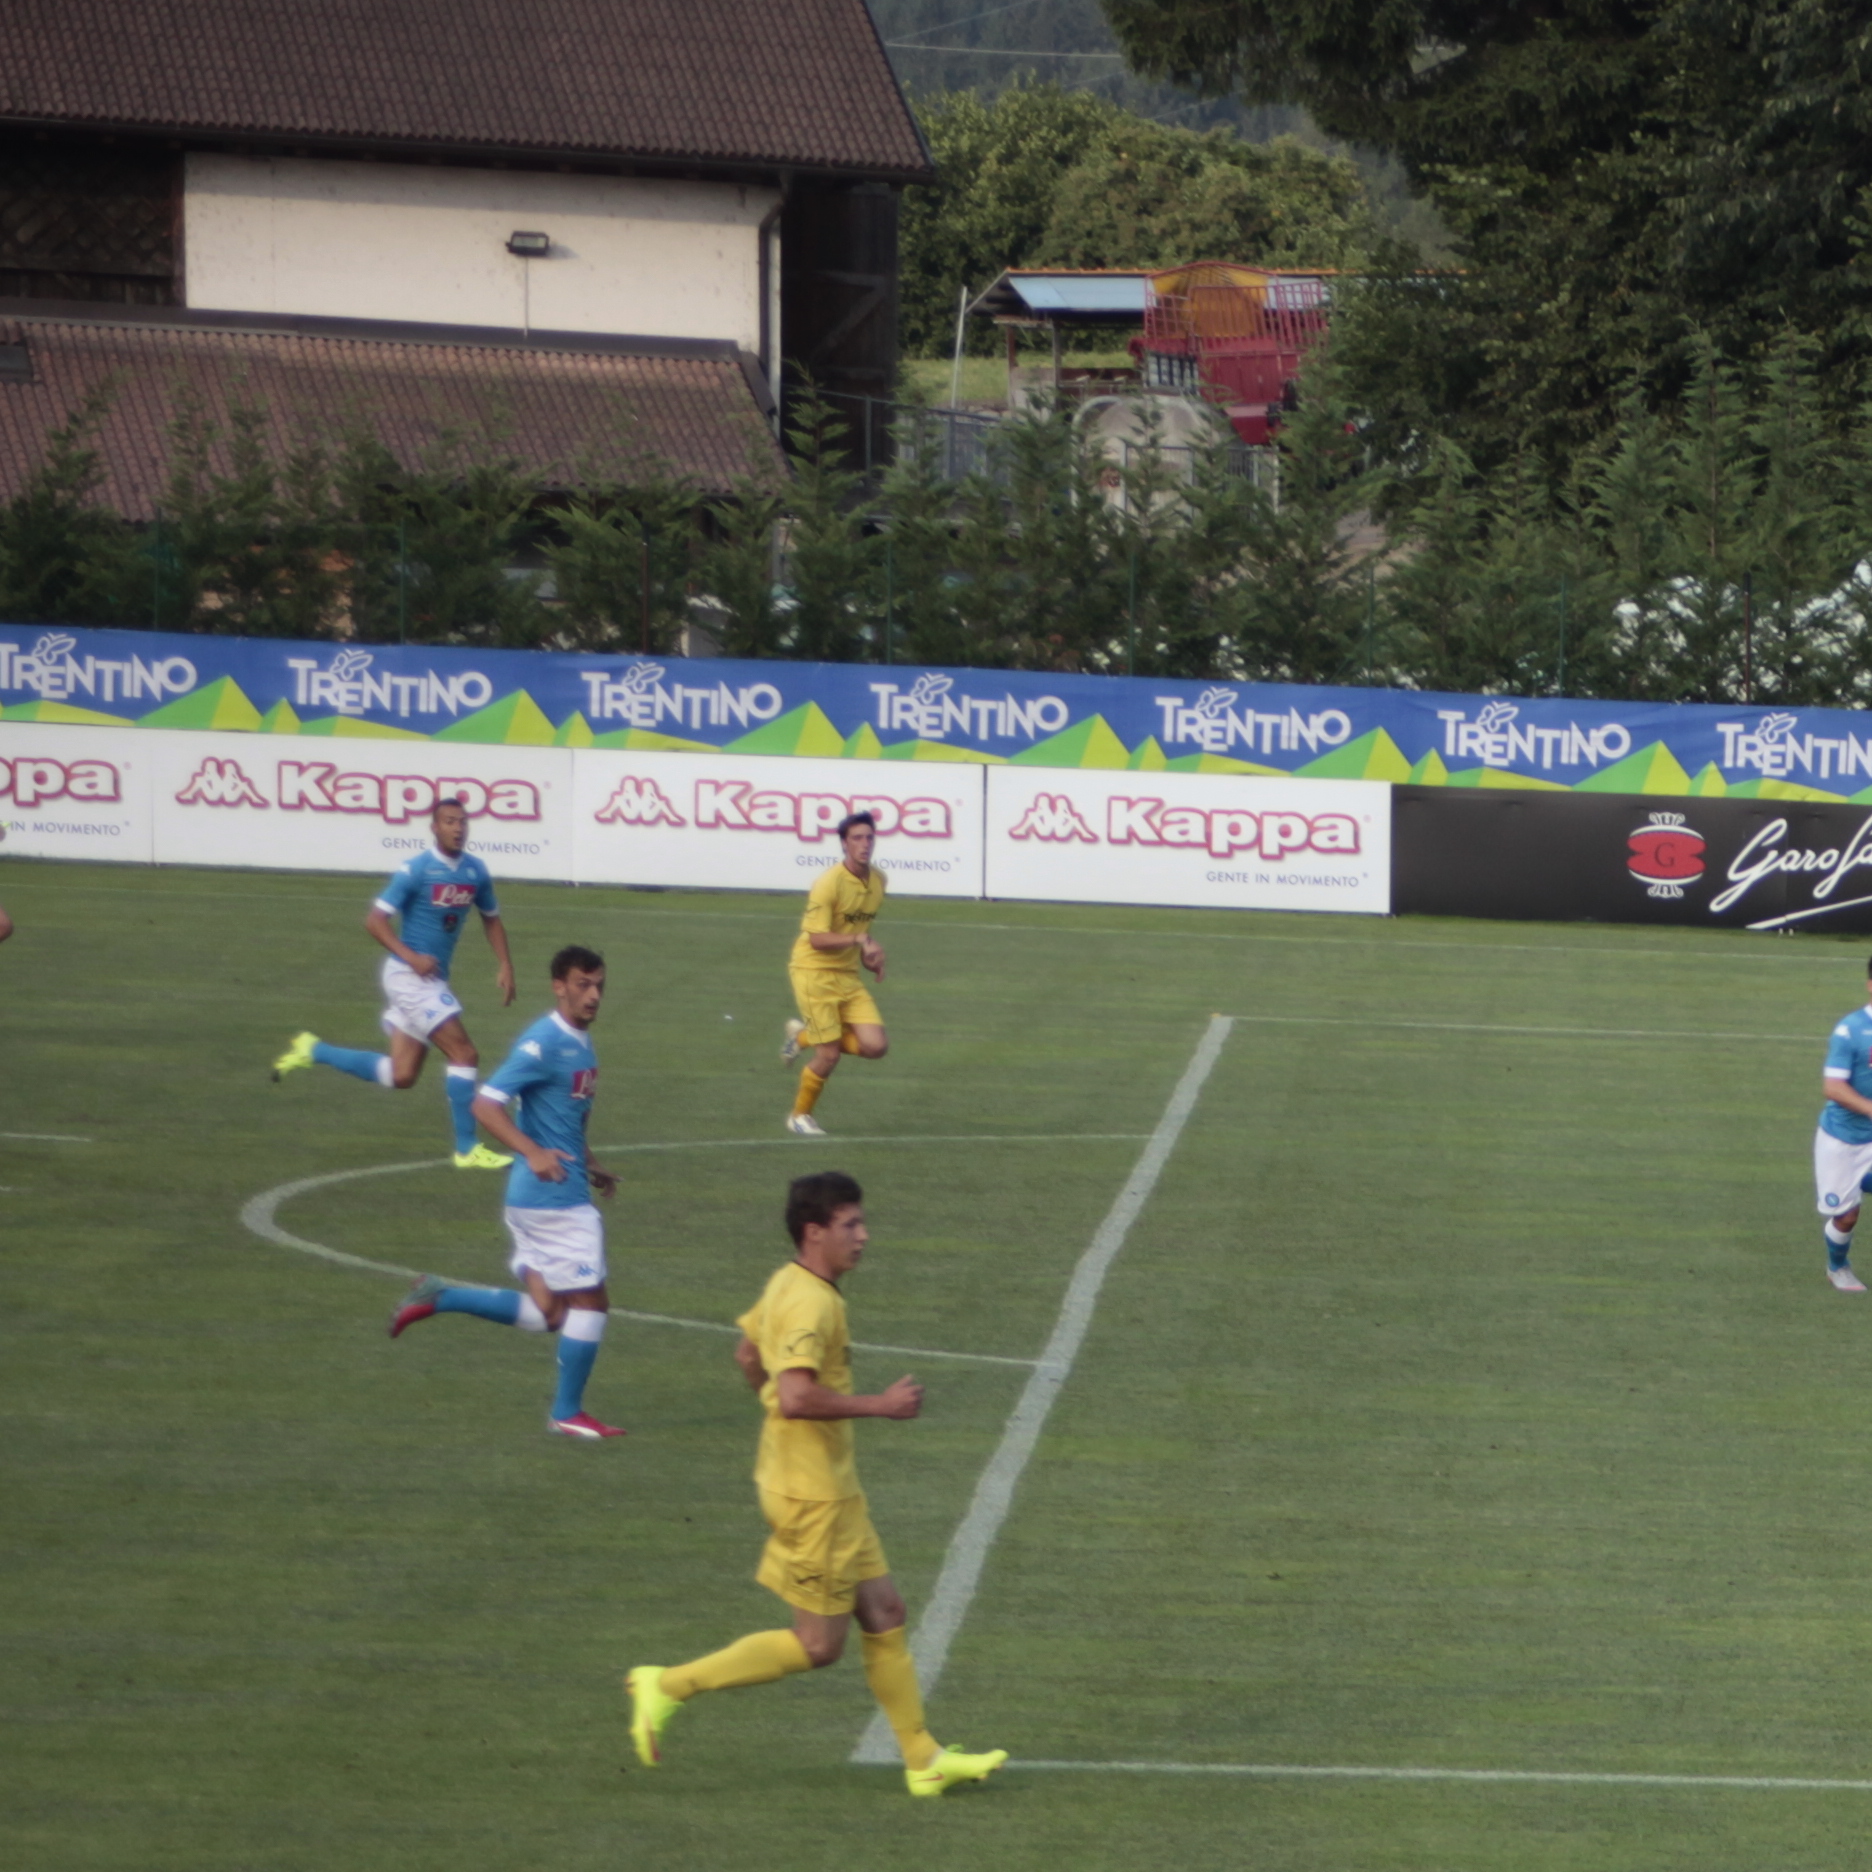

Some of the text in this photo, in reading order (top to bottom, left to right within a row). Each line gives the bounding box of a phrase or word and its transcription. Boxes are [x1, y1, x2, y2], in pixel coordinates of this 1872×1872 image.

[287, 657, 493, 718] TRENTINO
[581, 671, 783, 730] TRENTINO
[869, 682, 1070, 740] TRENTINO
[1154, 696, 1353, 755] TRENTINO
[1437, 709, 1632, 770] TRENTINO
[277, 760, 543, 825] Kappa
[694, 778, 954, 843] Kappa
[32, 821, 121, 837] MOVIMENTO
[381, 836, 541, 855] GENTE OVIMENTO
[1107, 796, 1361, 858] Kappa
[1206, 870, 1360, 888] GENTE IN MOVIMENTO
